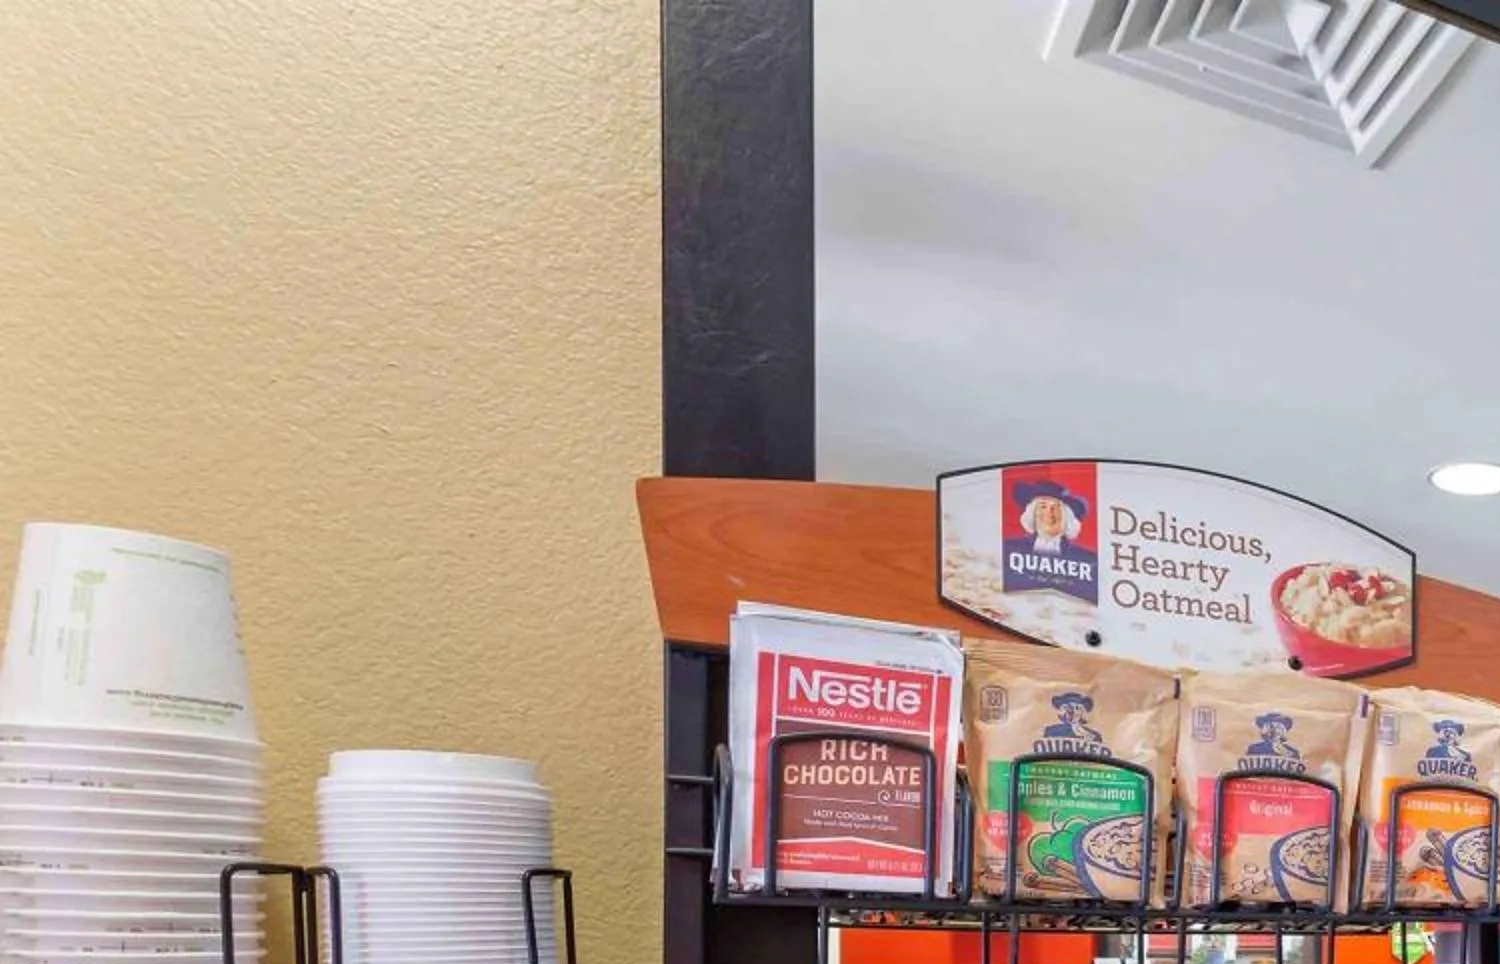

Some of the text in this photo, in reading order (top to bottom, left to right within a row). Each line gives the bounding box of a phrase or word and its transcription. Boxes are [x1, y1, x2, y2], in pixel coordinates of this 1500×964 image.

[1111, 507, 1272, 563] Delicious,
[1009, 552, 1093, 581] QUAKER
[1111, 543, 1229, 591] Hearty
[1112, 581, 1253, 624] Oatmeal
[821, 739, 888, 761] RICH
[1033, 738, 1112, 757] QUAKER
[783, 764, 921, 785] CHOCOLATE
[1238, 756, 1306, 773] QUAKER
[1417, 759, 1477, 781] QUAKER
[1018, 780, 1136, 801] pples & Cinnamon
[1249, 799, 1293, 817] Original
